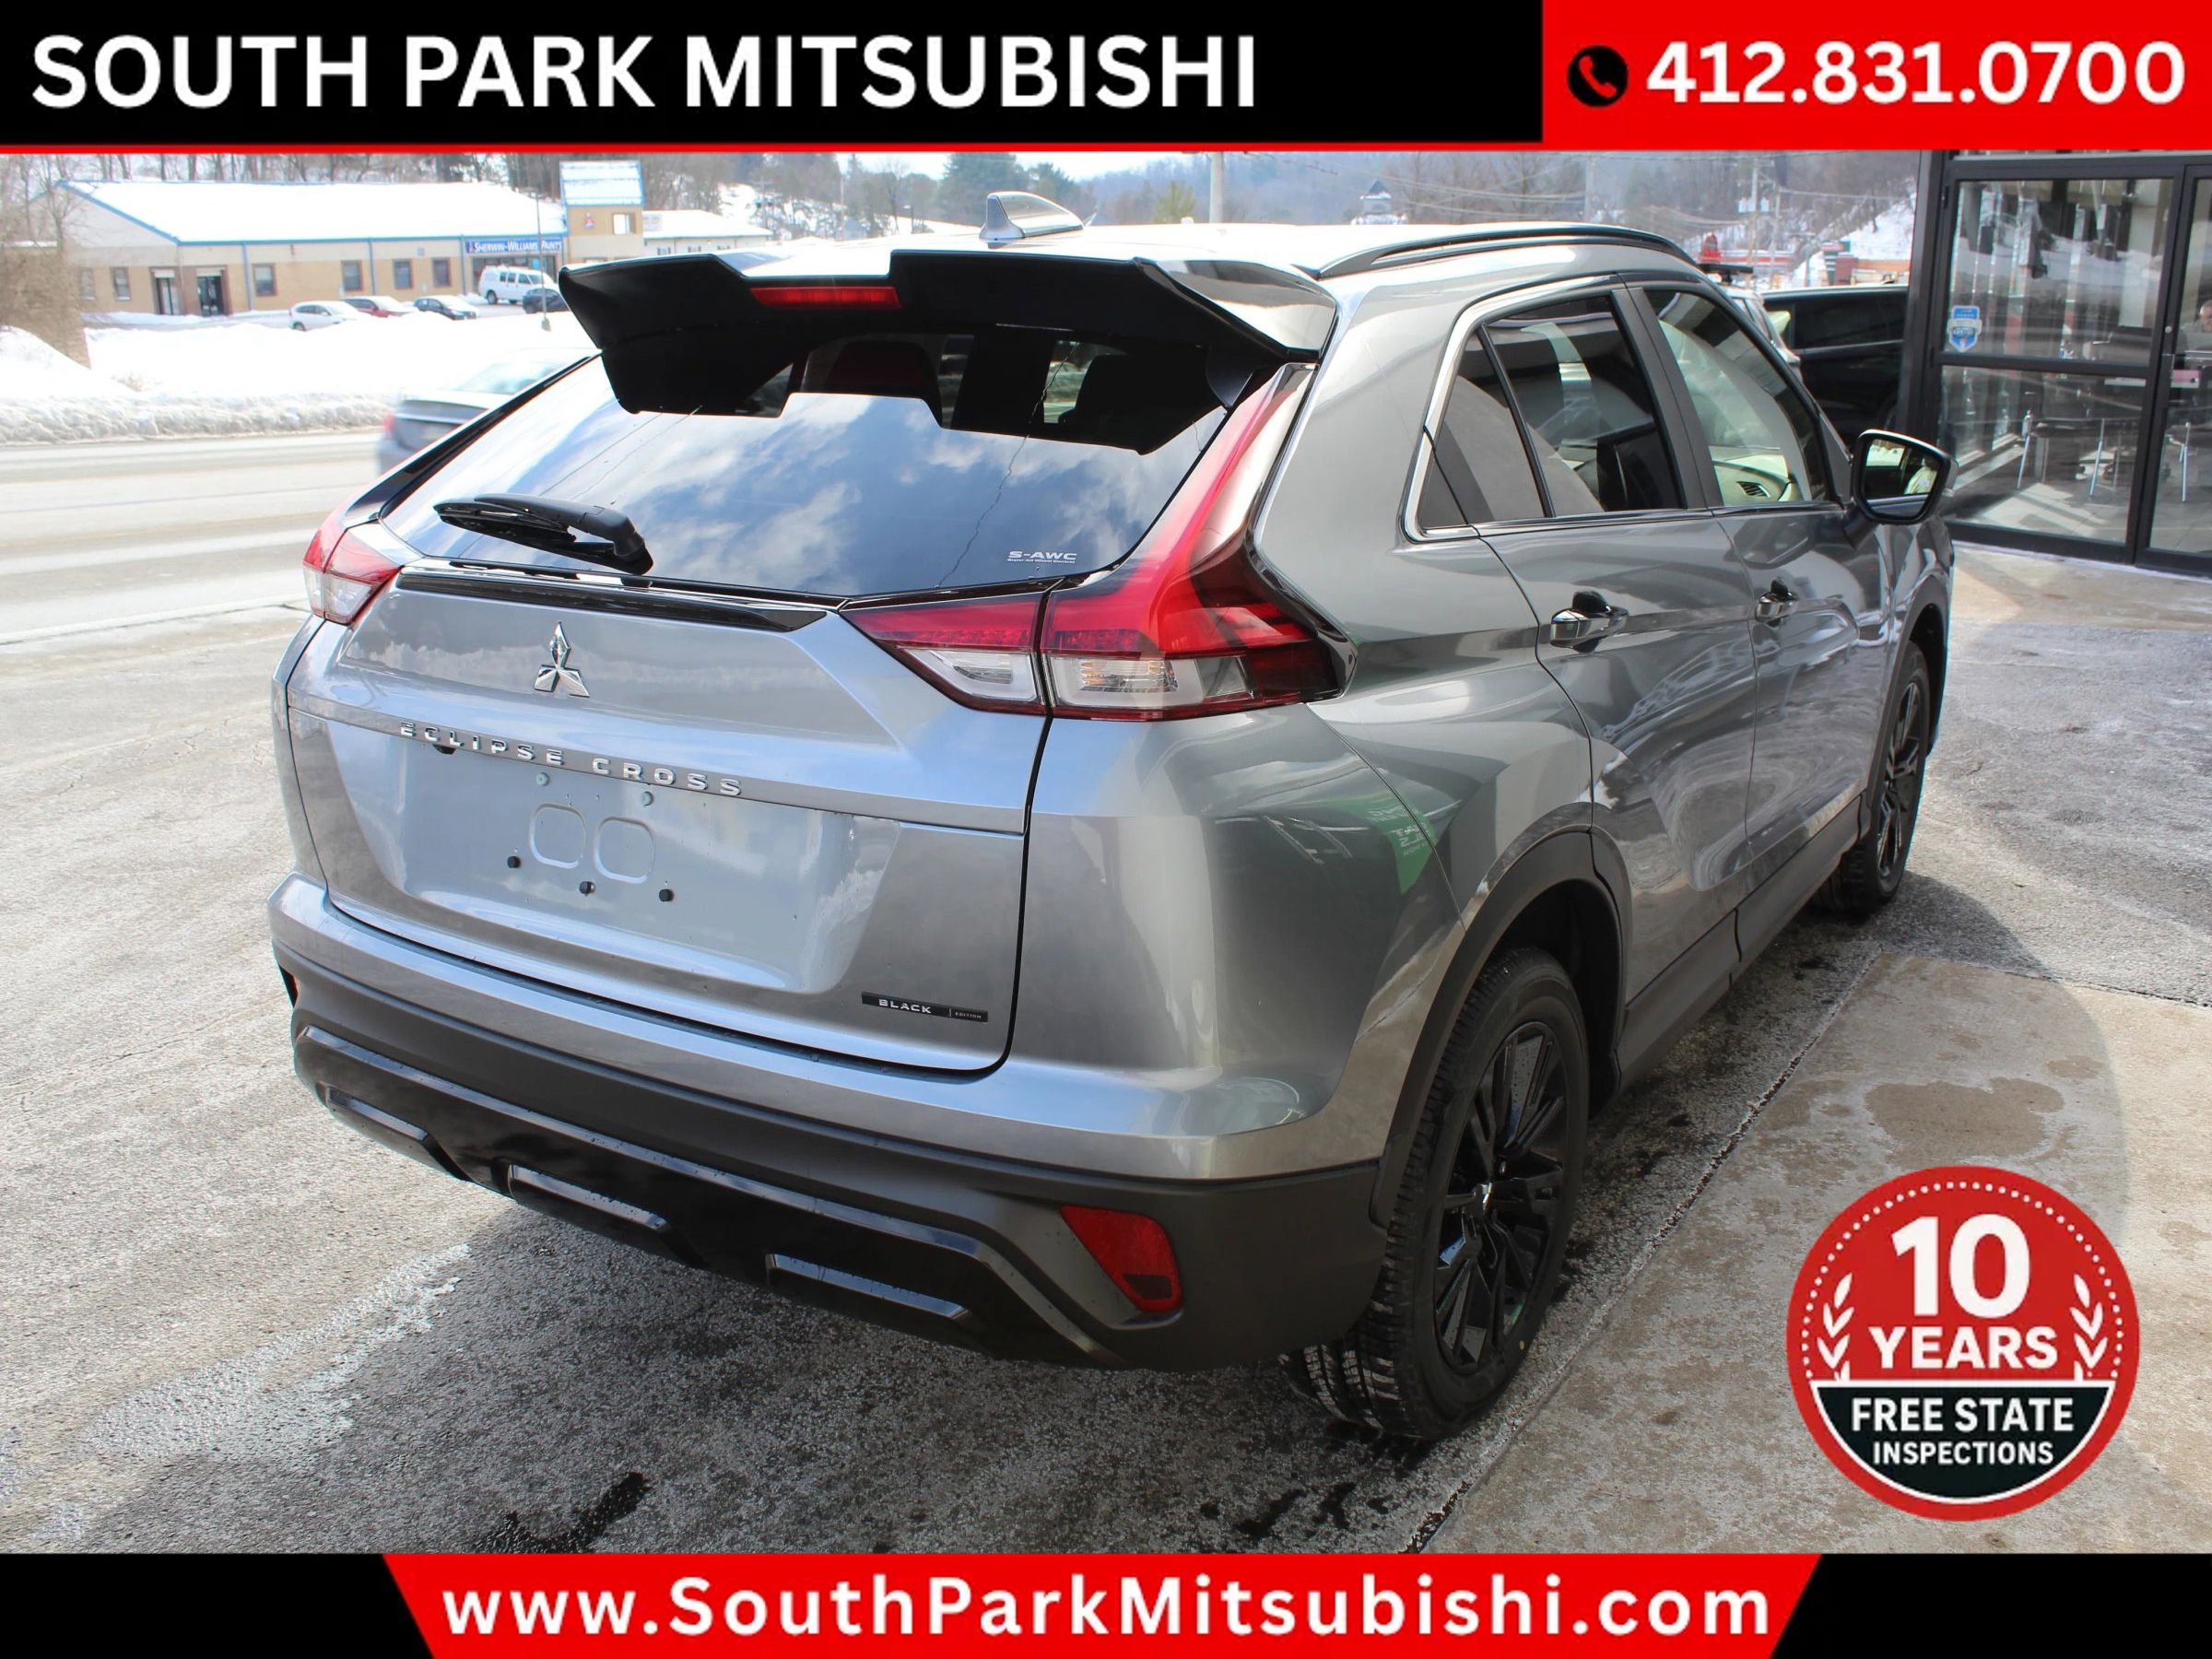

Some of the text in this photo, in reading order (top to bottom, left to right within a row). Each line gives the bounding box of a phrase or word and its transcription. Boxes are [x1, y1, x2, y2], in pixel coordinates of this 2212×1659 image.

[1008, 550, 1077, 560] S-AWC
[399, 721, 742, 796] ECLIPSE CROSS
[878, 998, 982, 1019] BLACK EDITION
